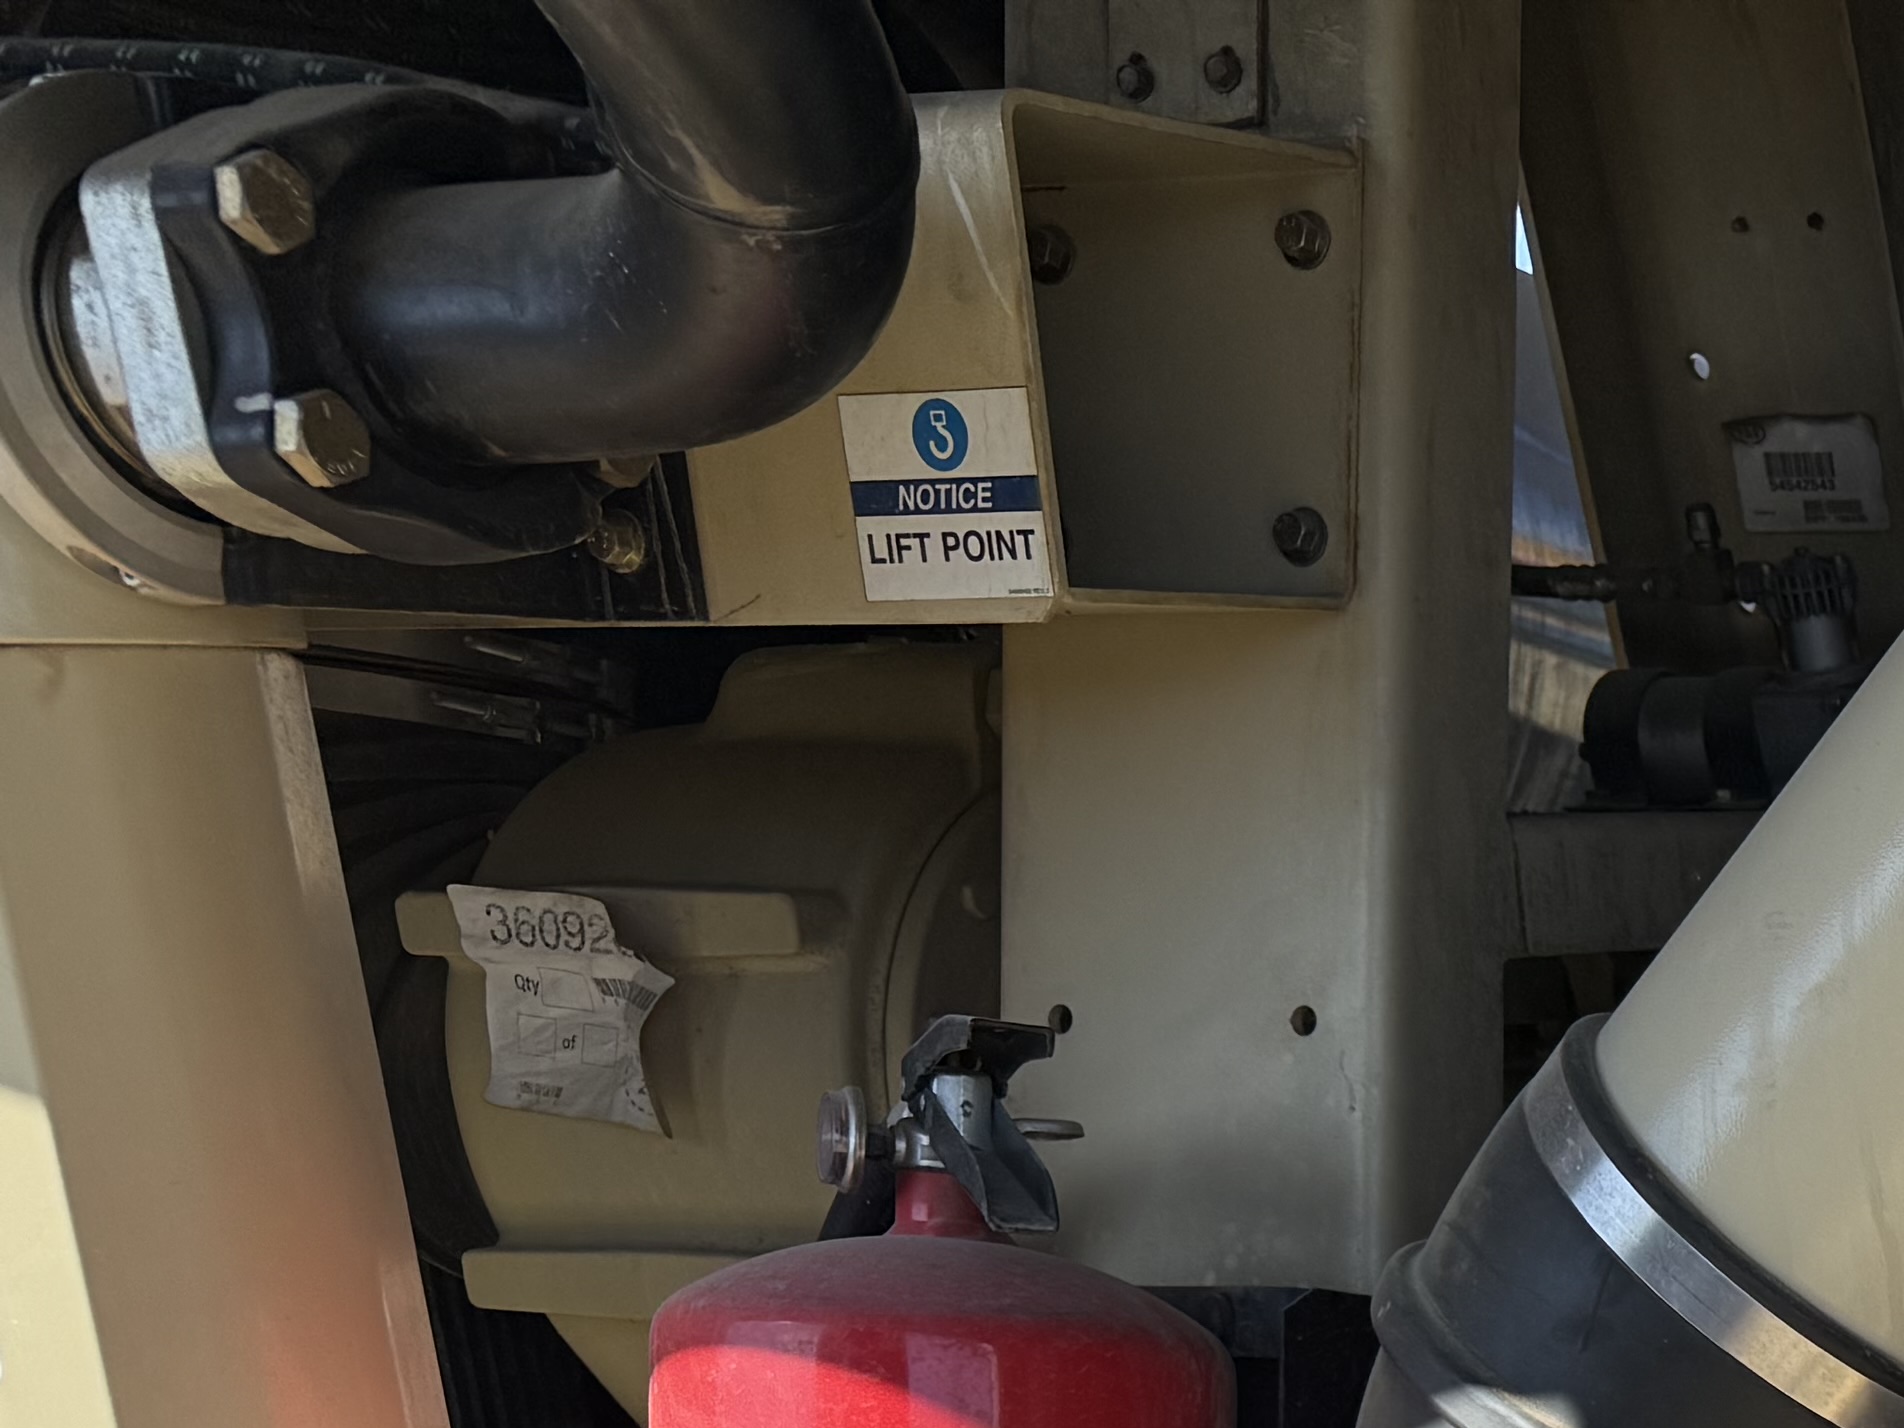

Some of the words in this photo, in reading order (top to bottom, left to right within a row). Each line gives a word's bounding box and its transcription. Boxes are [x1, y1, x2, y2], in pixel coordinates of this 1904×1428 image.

[898, 482, 993, 511] NOTICE
[867, 532, 930, 564] LIFT
[941, 529, 1035, 563] POINT
[485, 903, 622, 955] 36092
[514, 973, 539, 996] Qty
[562, 1034, 577, 1050] of
